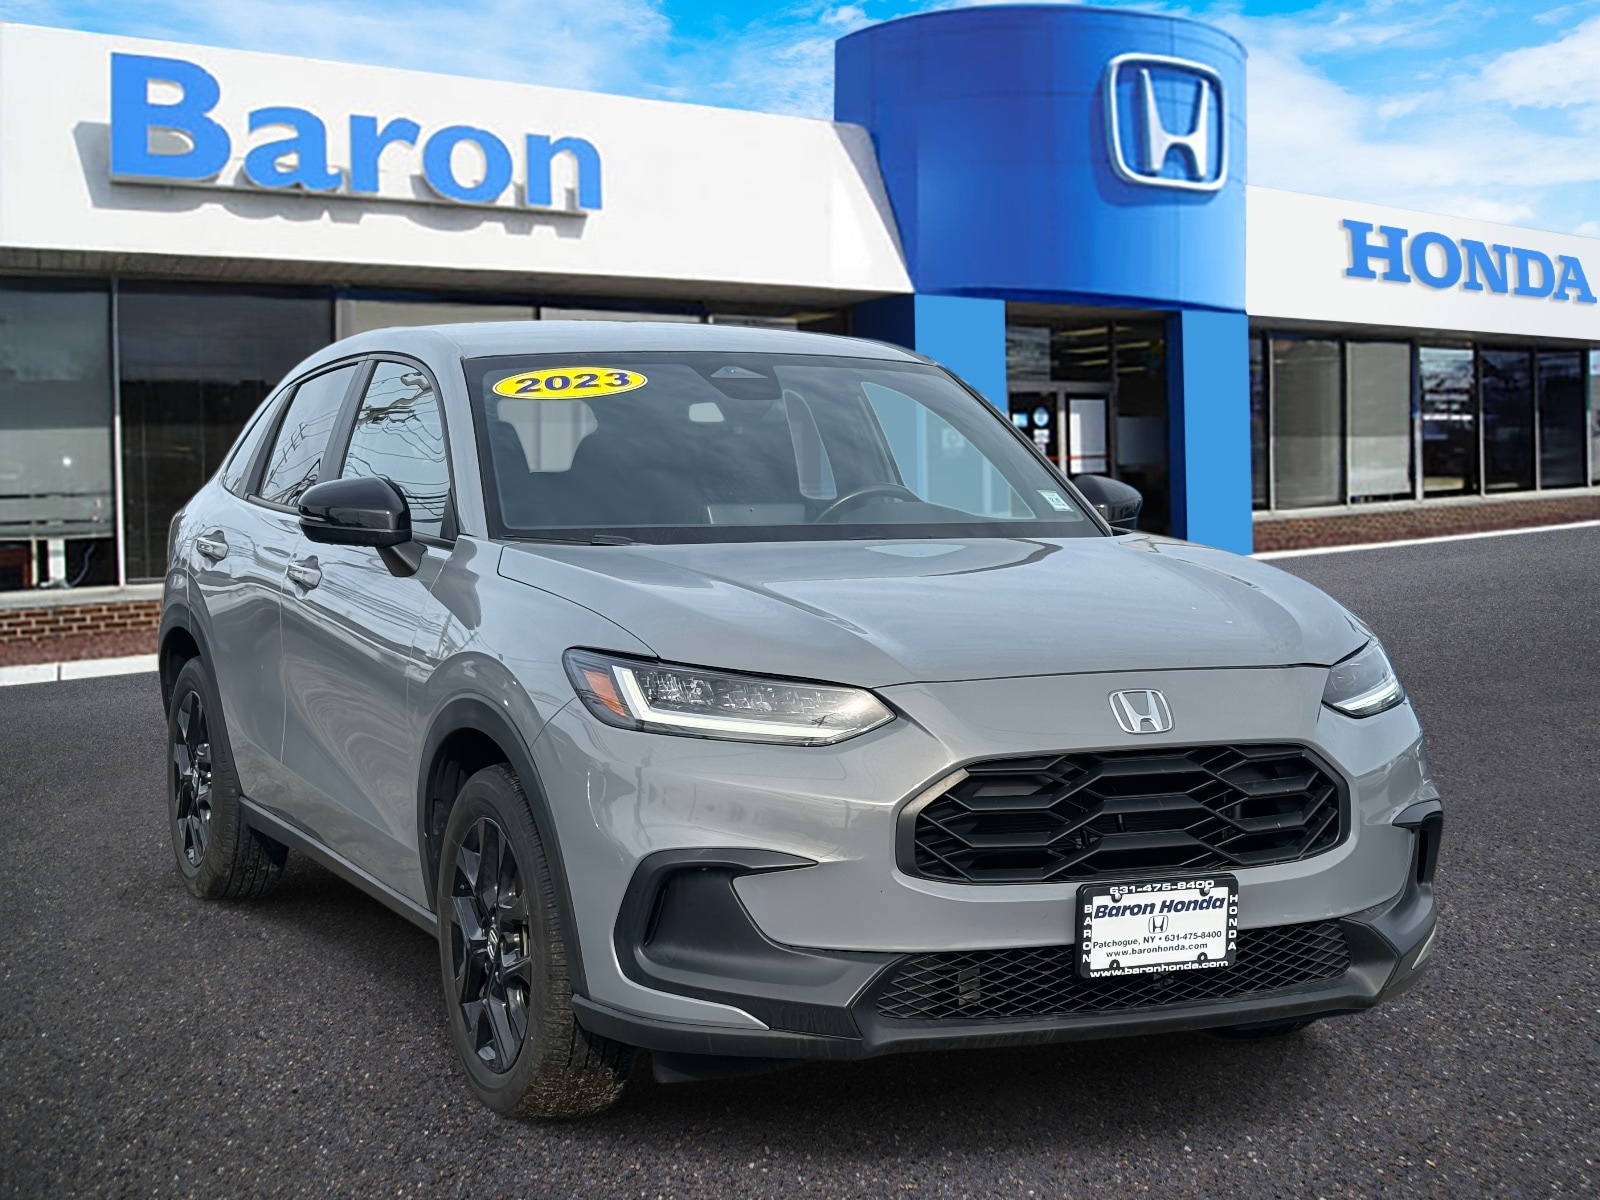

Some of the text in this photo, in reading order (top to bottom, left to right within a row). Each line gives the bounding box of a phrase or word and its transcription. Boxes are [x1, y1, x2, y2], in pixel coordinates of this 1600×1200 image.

[109, 52, 603, 211] Baron
[1342, 218, 1598, 304] HONDA
[514, 372, 632, 394] 2023
[1093, 896, 1226, 919] Baron Honda
[1082, 905, 1093, 963] BARON
[1227, 894, 1239, 951] HONDA
[1092, 930, 1222, 950] Patchogue, NY 631-475-8400
[1106, 942, 1208, 958] www.baronhonda.com
[1089, 960, 1229, 978] www.baronhonda.com
